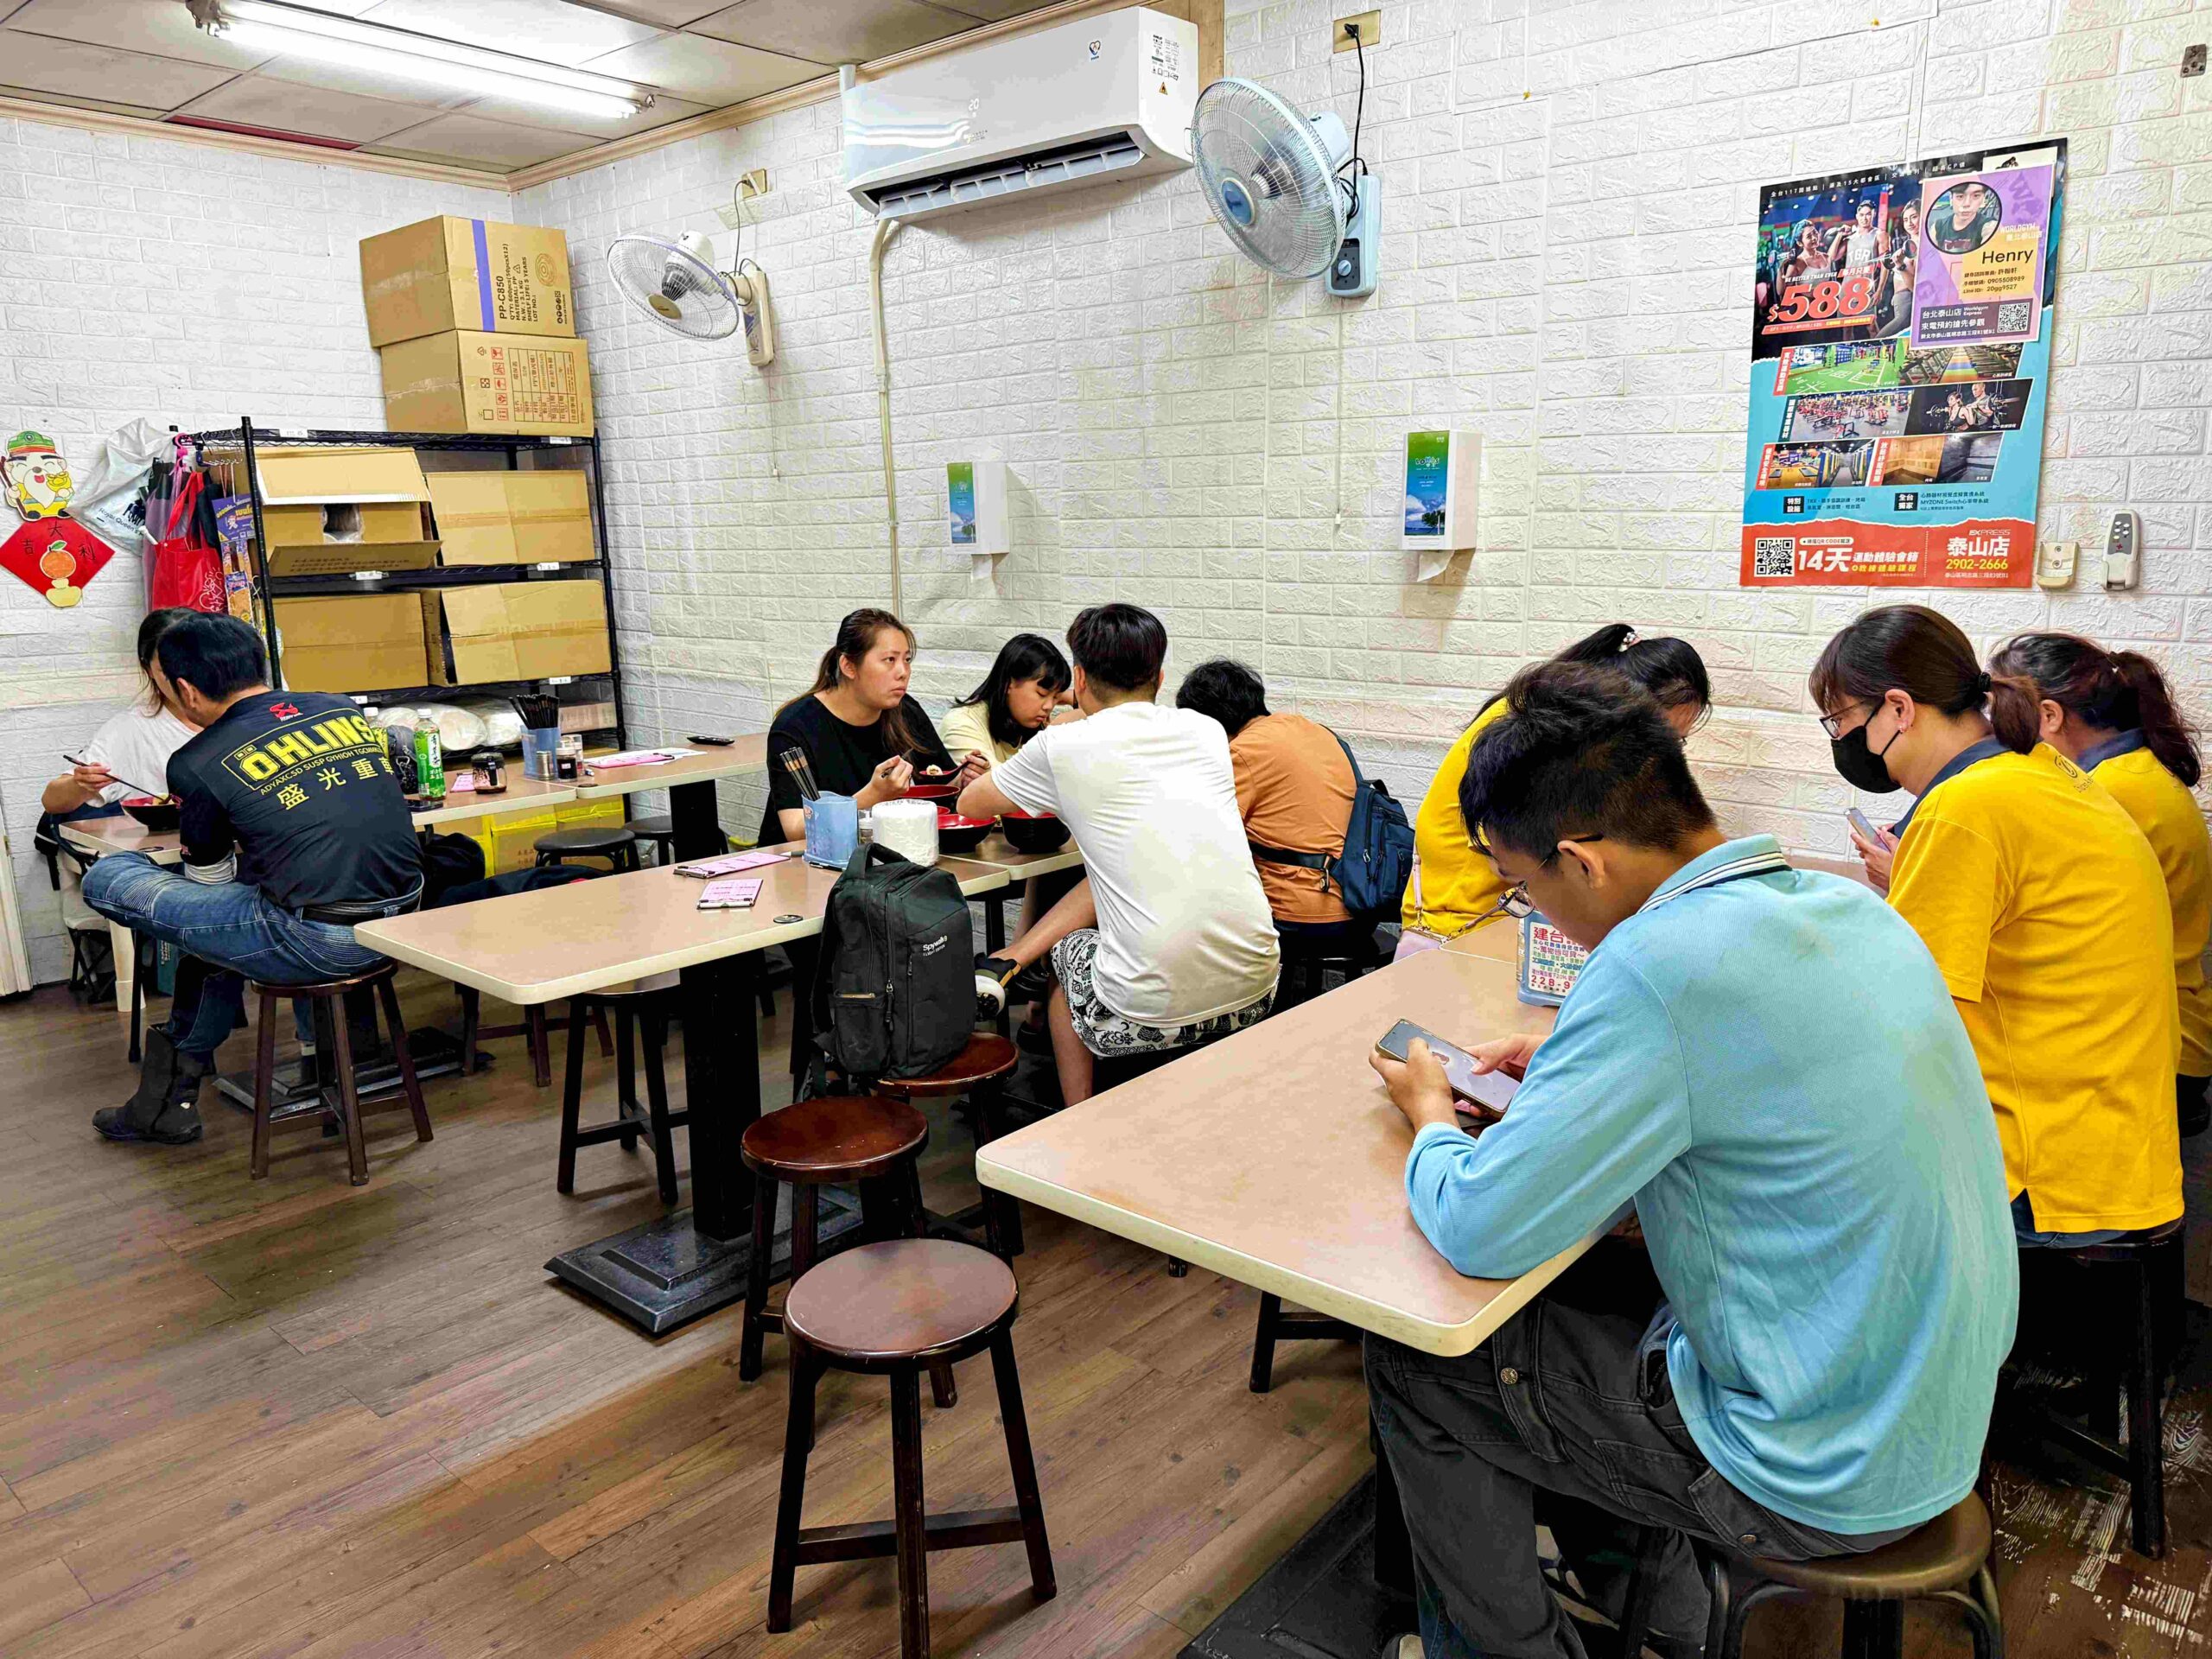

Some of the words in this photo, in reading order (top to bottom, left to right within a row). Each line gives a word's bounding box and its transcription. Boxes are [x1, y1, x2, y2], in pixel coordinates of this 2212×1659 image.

[1982, 249, 2033, 264] Henry
[513, 276, 518, 284] PP
[496, 276, 507, 319] PP-C850
[1923, 308, 1962, 319] 台北泰山店
[48, 521, 62, 538] 大
[21, 539, 33, 555] 吉
[78, 543, 95, 561] 利
[1947, 536, 2010, 557] 泰山店
[1798, 548, 1853, 572] 14天
[1946, 559, 2008, 570] 2902-2666
[234, 715, 377, 782] ÖHLINS
[303, 759, 325, 770] SUSP
[1531, 975, 1576, 989] 228-9
